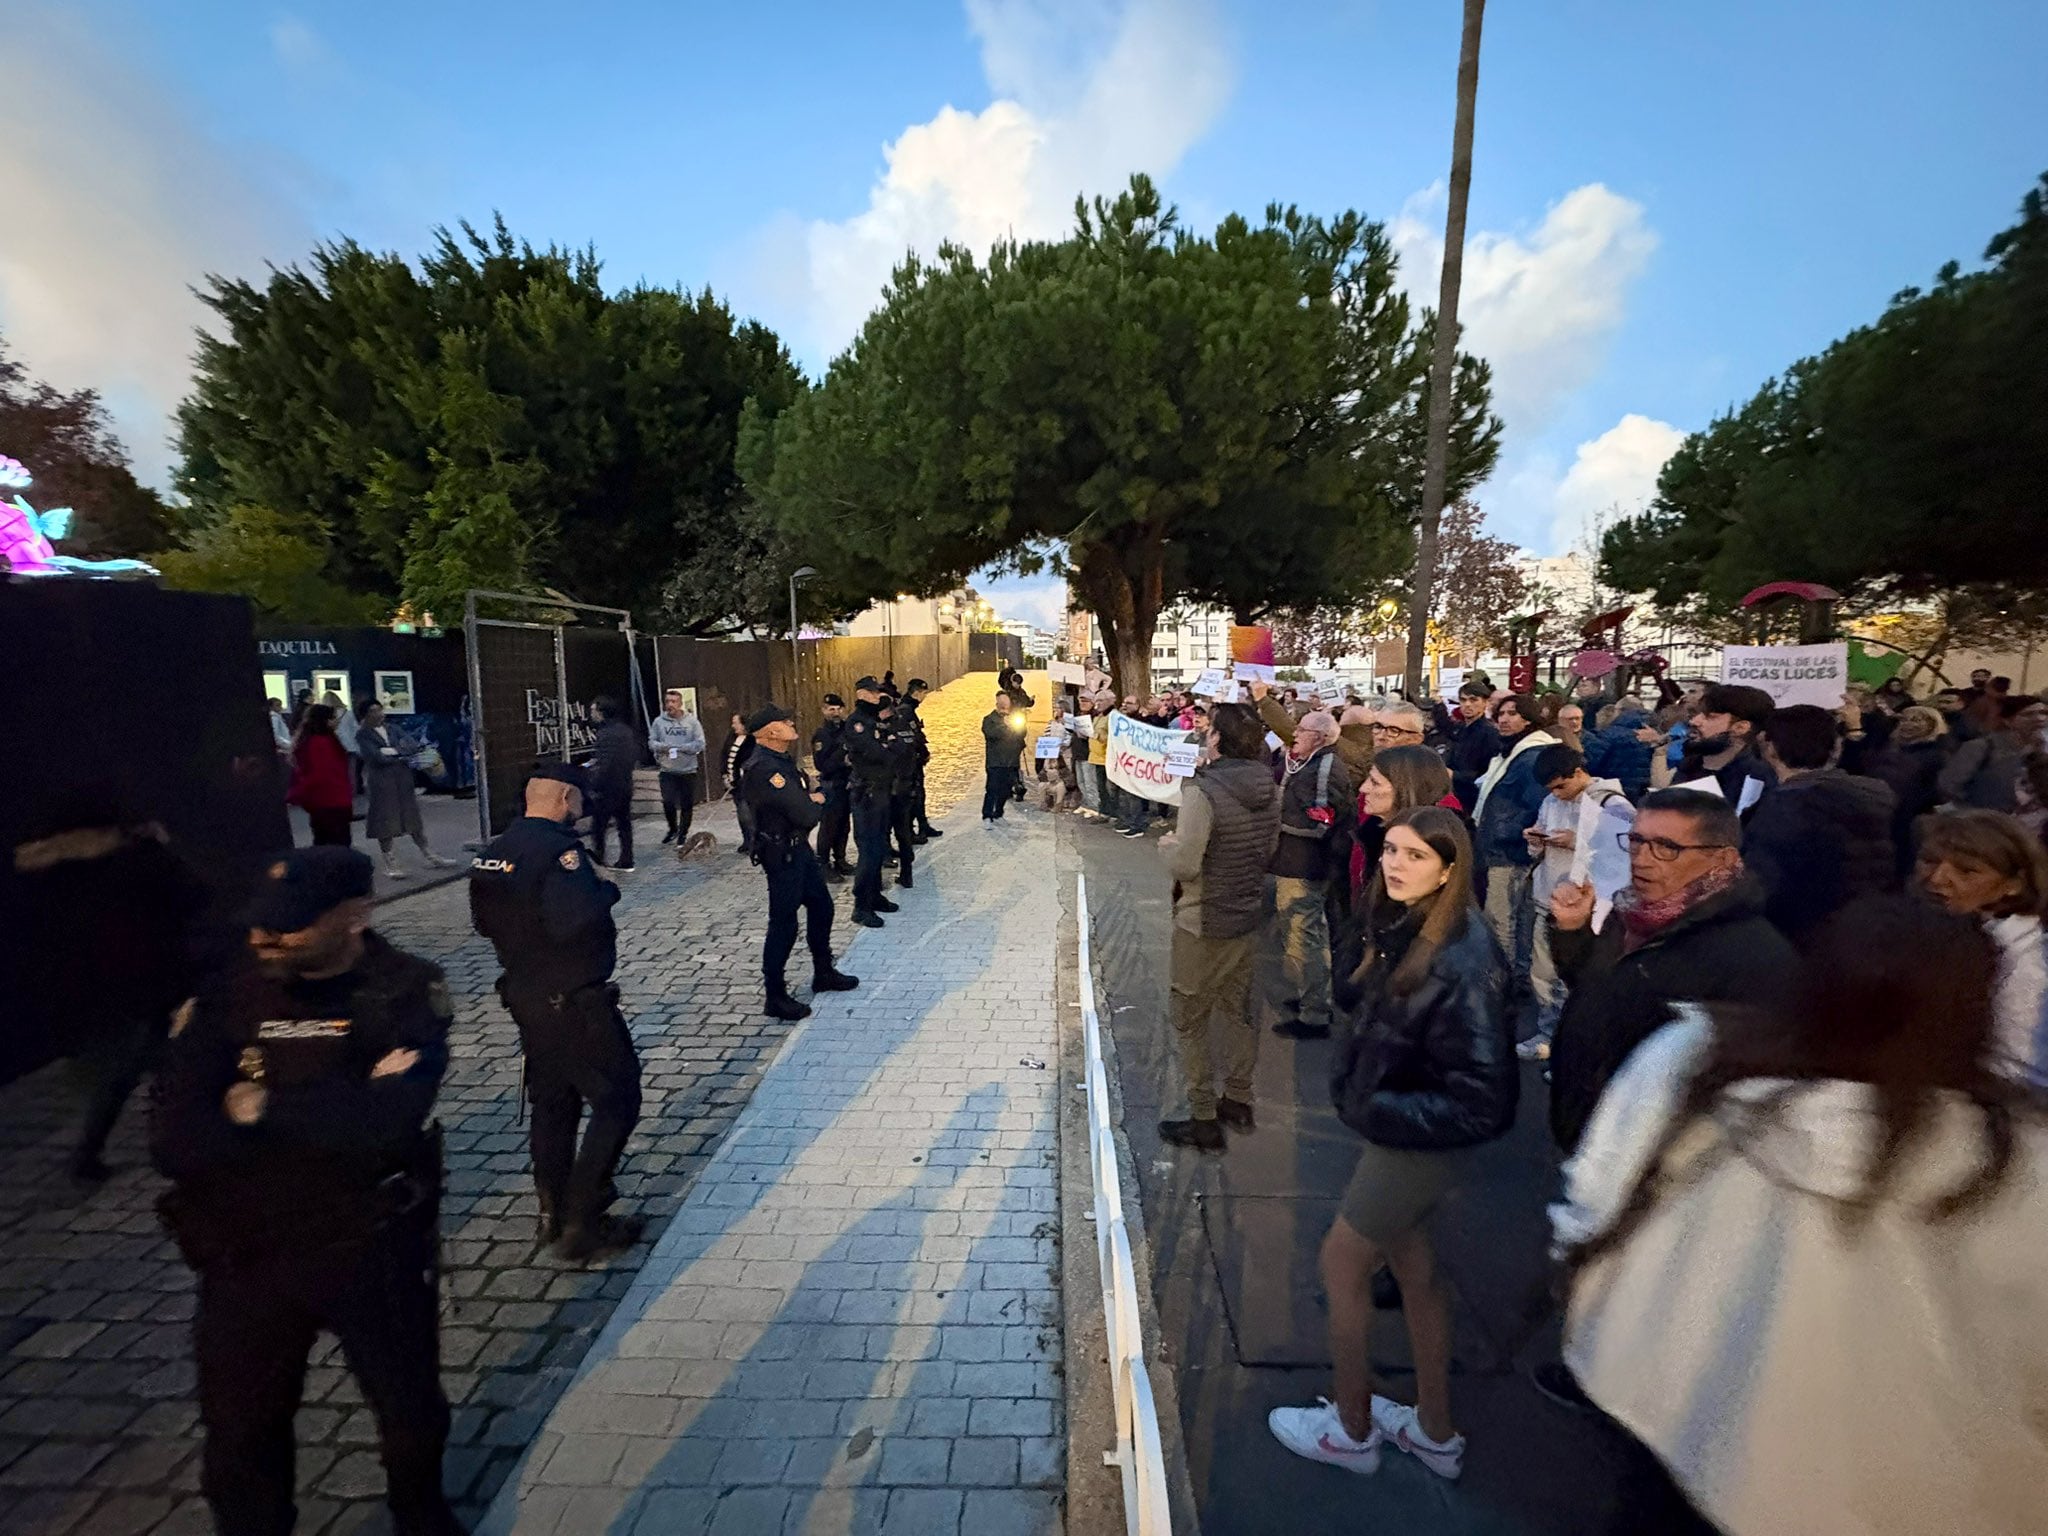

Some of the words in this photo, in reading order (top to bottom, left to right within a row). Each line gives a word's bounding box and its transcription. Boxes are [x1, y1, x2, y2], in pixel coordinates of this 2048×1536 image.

[258, 640, 338, 657] TAQUILLA
[1728, 657, 1741, 666] EL
[1743, 656, 1791, 667] FESTIVAL
[1796, 656, 1810, 666] DE
[1814, 654, 1837, 666] LAS
[1728, 667, 1780, 680] POCAS
[1785, 665, 1838, 680] LUCES
[526, 688, 589, 721] FESTVAL
[664, 725, 689, 736] VANS
[1113, 716, 1173, 755] PARQUE
